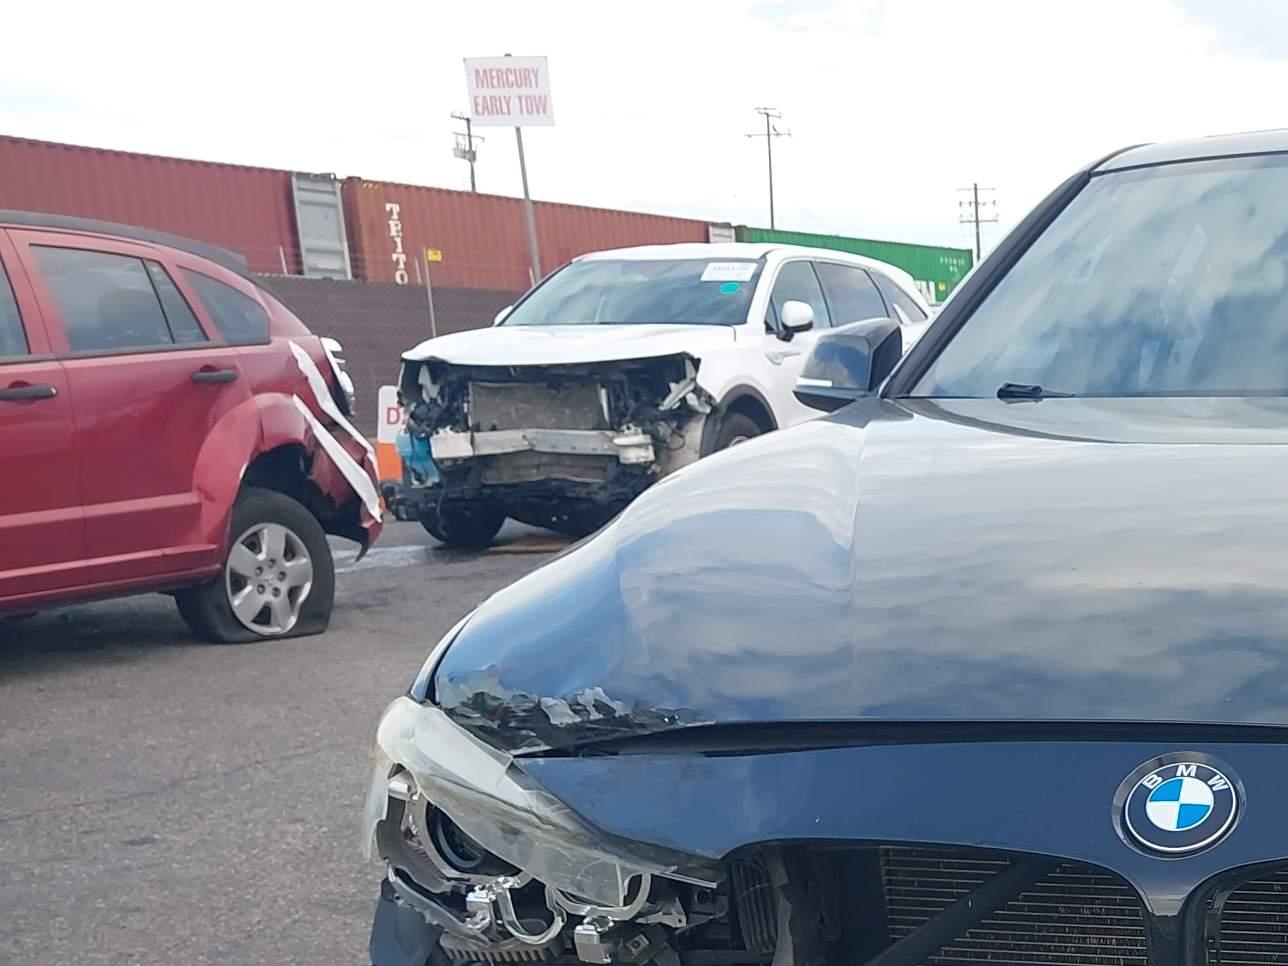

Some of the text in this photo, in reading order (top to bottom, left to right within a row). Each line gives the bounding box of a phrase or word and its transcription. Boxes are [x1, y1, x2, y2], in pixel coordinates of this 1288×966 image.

[474, 67, 540, 89] MERCURY
[473, 93, 548, 116] EARLY TOW
[1141, 763, 1230, 792] BMW
